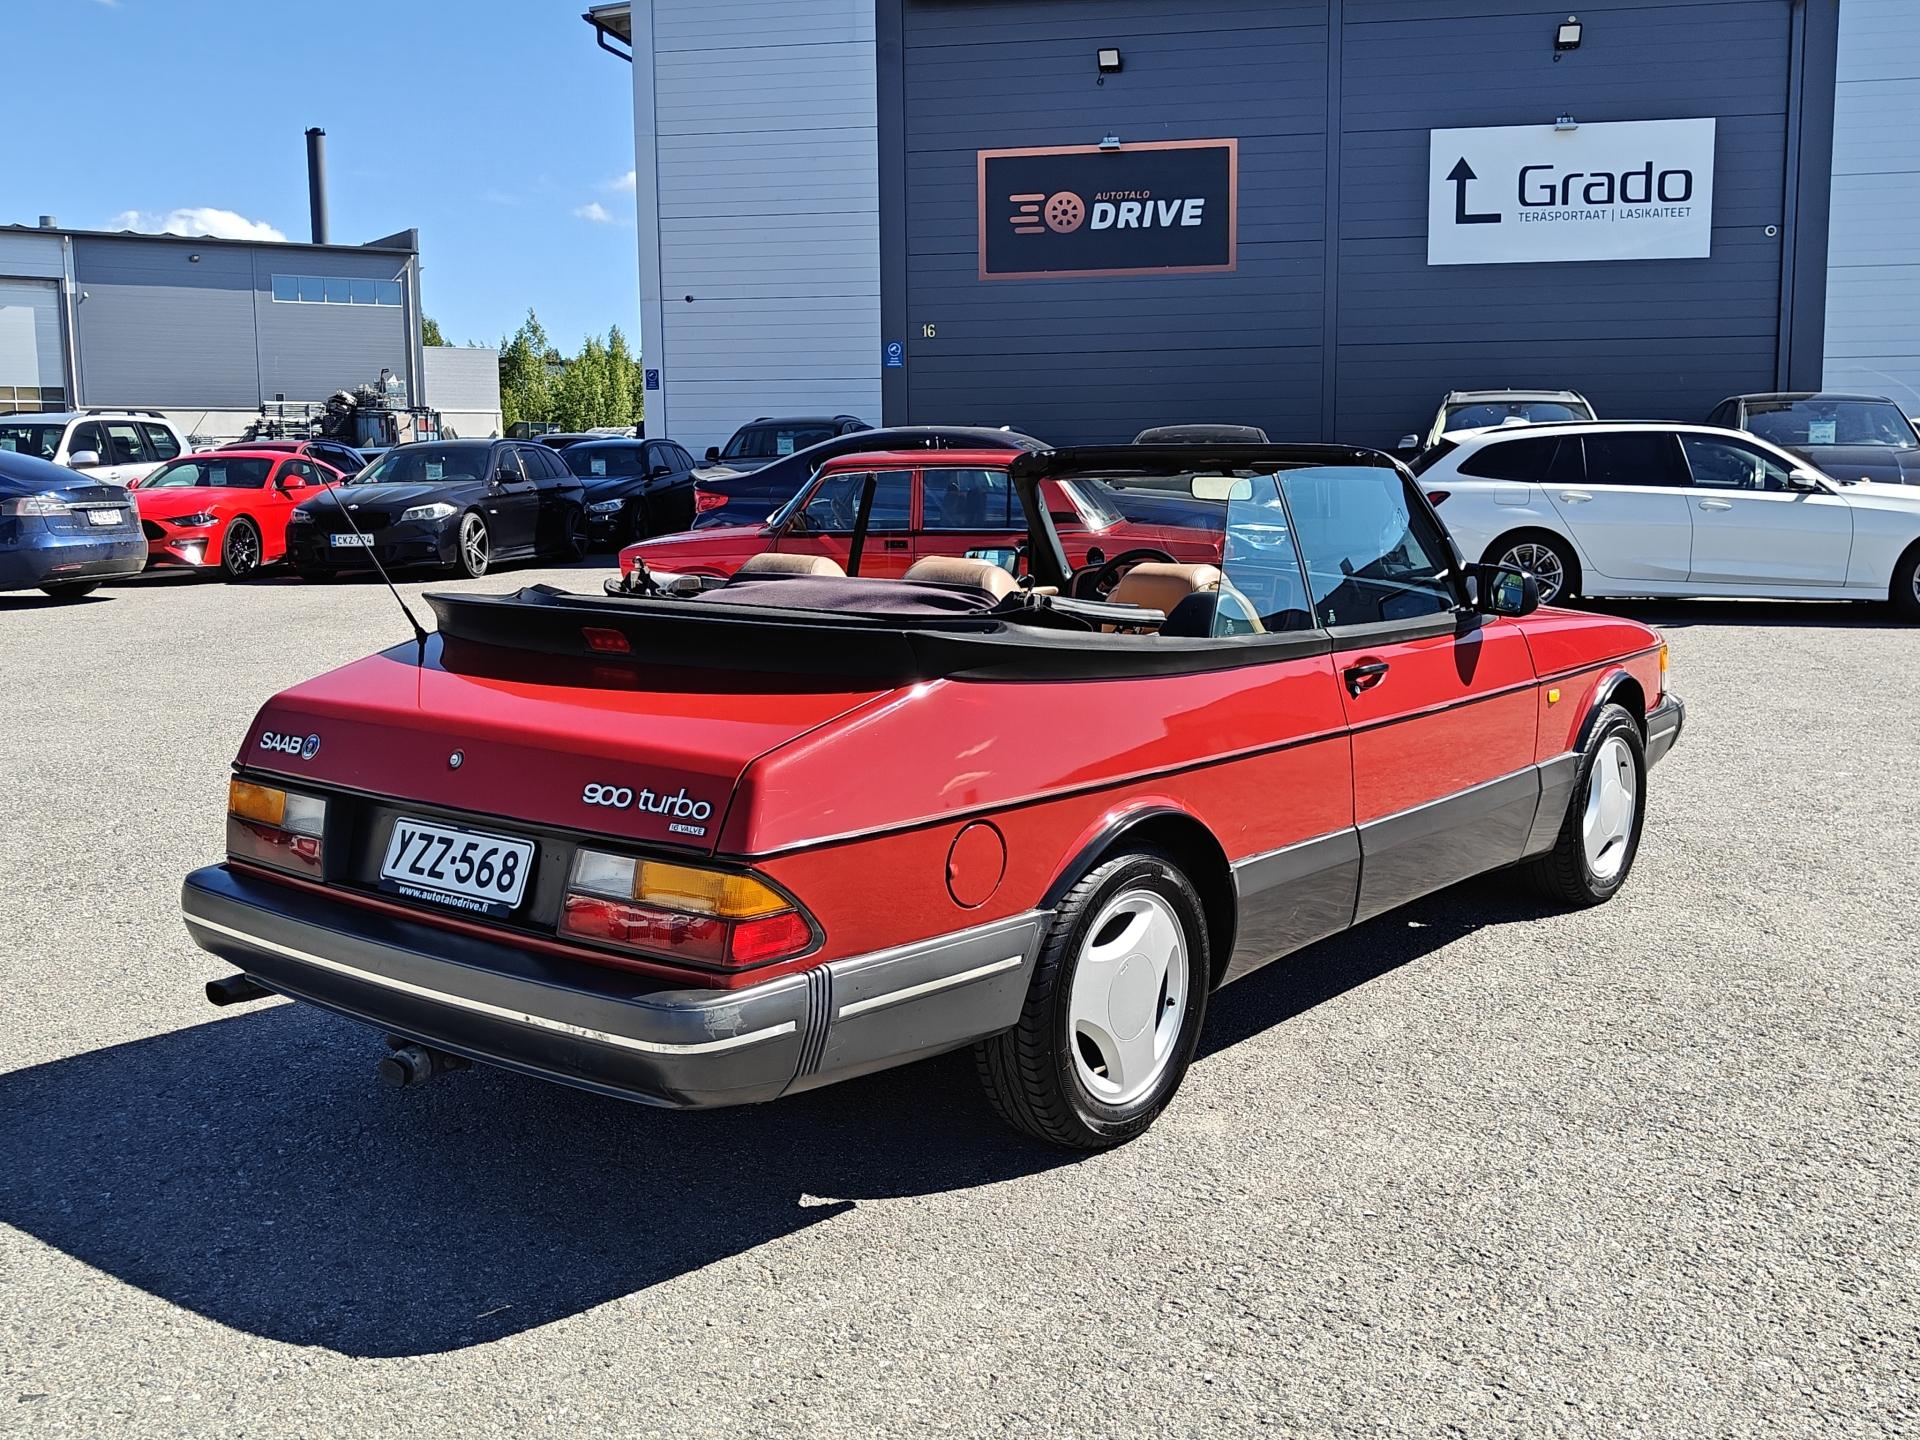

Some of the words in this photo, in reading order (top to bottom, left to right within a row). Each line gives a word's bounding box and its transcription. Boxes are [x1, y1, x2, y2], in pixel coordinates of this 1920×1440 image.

[1095, 190, 1150, 200] AUTOTALO
[1518, 161, 1692, 206] Grado
[1090, 198, 1205, 230] DRIVE
[1518, 210, 1606, 222] TERÄSPORTAAT
[1620, 207, 1692, 219] LASIKAITEET
[922, 324, 936, 337] 16
[260, 732, 302, 754] SAAB
[582, 783, 632, 808] 900
[638, 788, 711, 820] turbo
[681, 826, 704, 835] VALVE
[391, 829, 519, 893] YZZ-568
[399, 885, 489, 913] www.autotalodrive.fi
